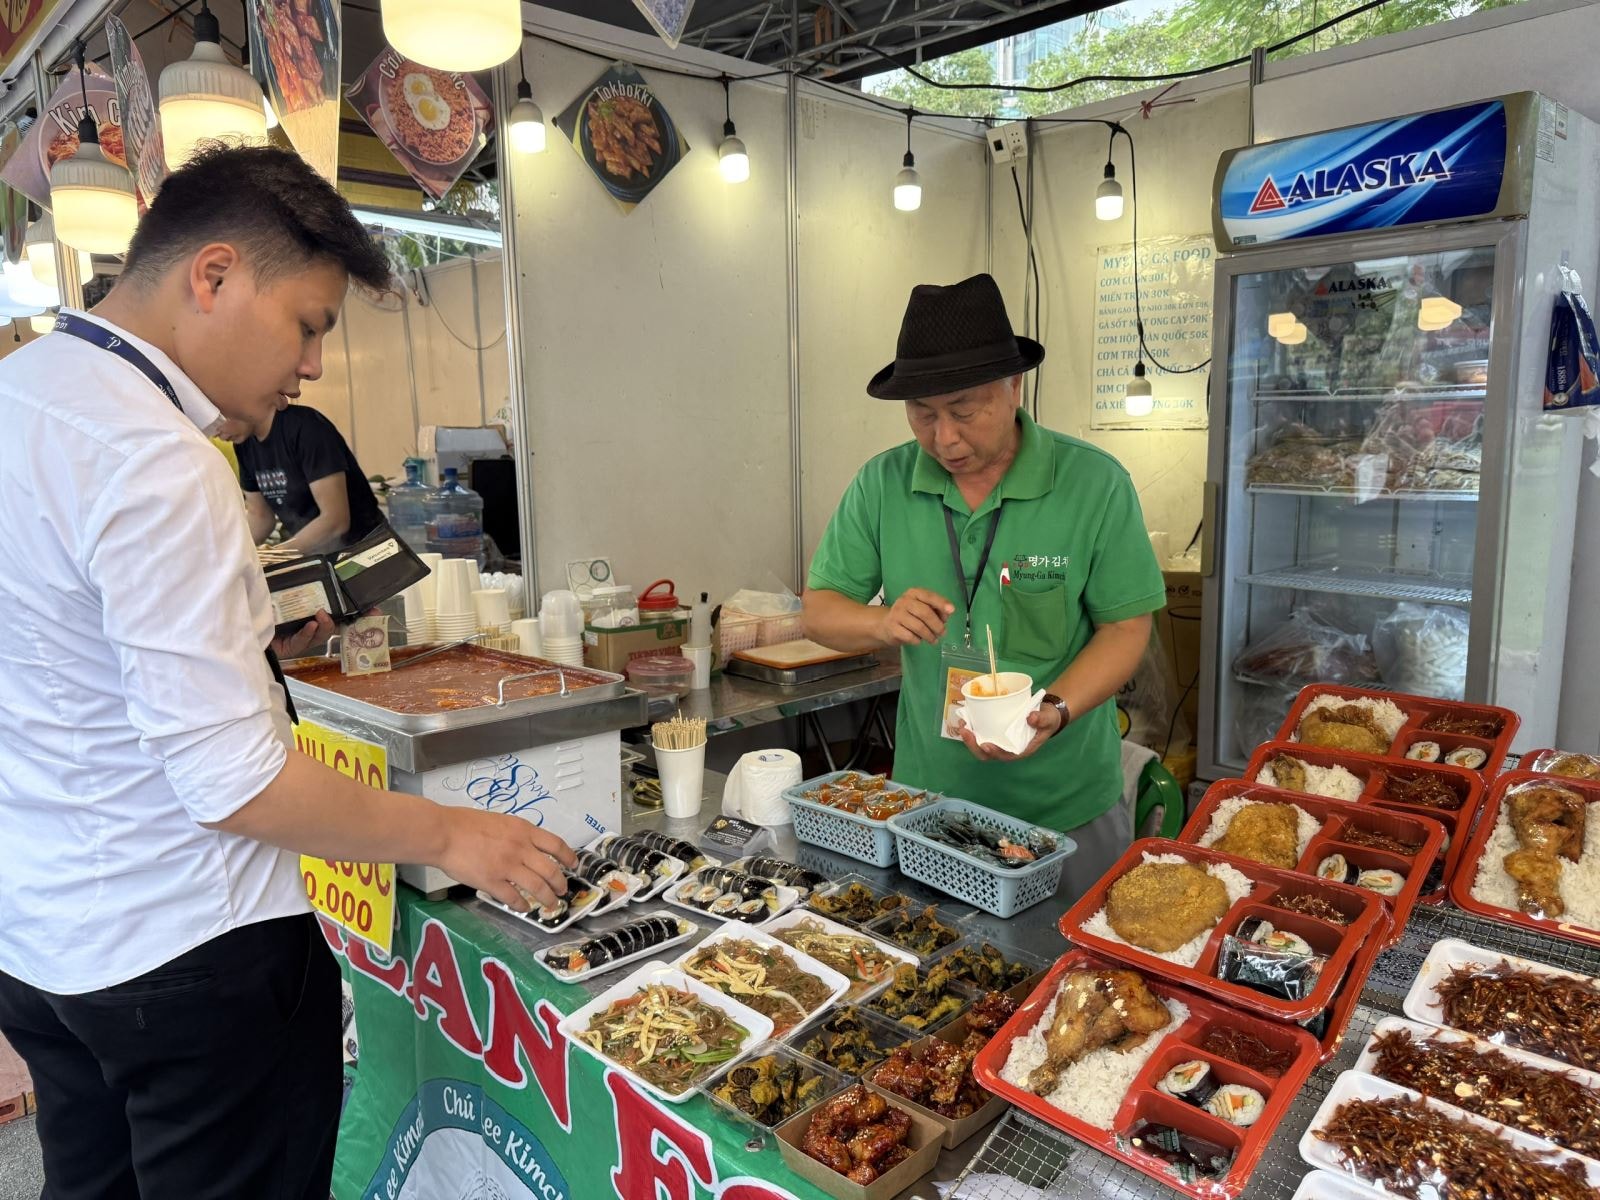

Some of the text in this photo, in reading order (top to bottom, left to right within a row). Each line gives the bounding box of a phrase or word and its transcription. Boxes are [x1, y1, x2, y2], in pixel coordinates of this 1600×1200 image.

[594, 80, 655, 107] Tokbokki
[1287, 149, 1451, 204] ALASKA
[1173, 247, 1211, 262] FOOD
[1328, 276, 1387, 294] ALASKA
[1151, 289, 1169, 298] 30K
[1190, 314, 1208, 324] 50K
[1189, 330, 1208, 340] 50K
[1151, 348, 1170, 358] 50K
[1096, 384, 1114, 395] KIM
[1028, 555, 1050, 568] 명가
[584, 813, 606, 834] STEEL
[303, 871, 373, 932] 0.000
[443, 1086, 476, 1121] Chú
